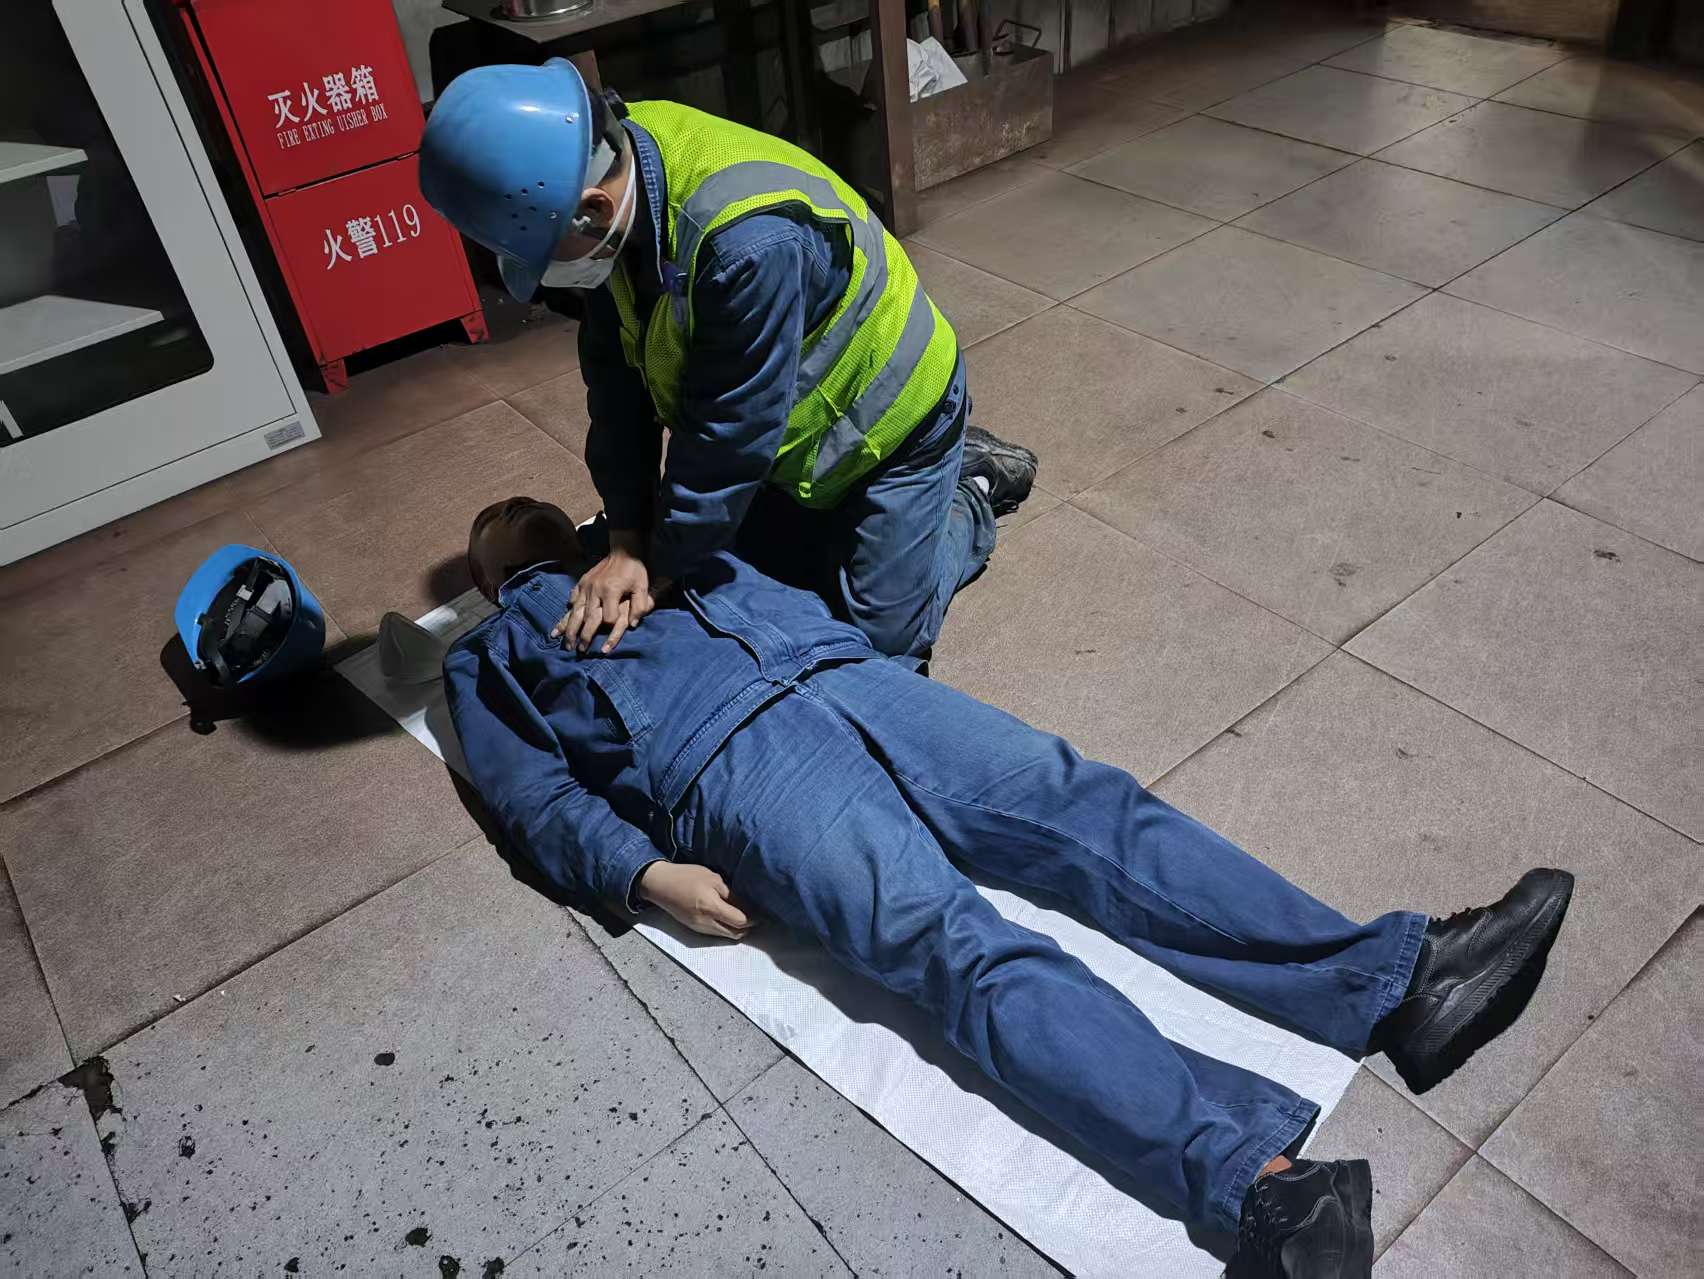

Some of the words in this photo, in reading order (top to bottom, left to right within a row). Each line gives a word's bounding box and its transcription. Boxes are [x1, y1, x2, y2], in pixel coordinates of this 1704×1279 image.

[267, 65, 379, 129] 灭火器箱
[277, 129, 300, 149] FIRE
[303, 118, 334, 142] EXTING
[337, 109, 368, 131] UISHER
[371, 103, 388, 122] BOX
[323, 204, 421, 269] 火警119
